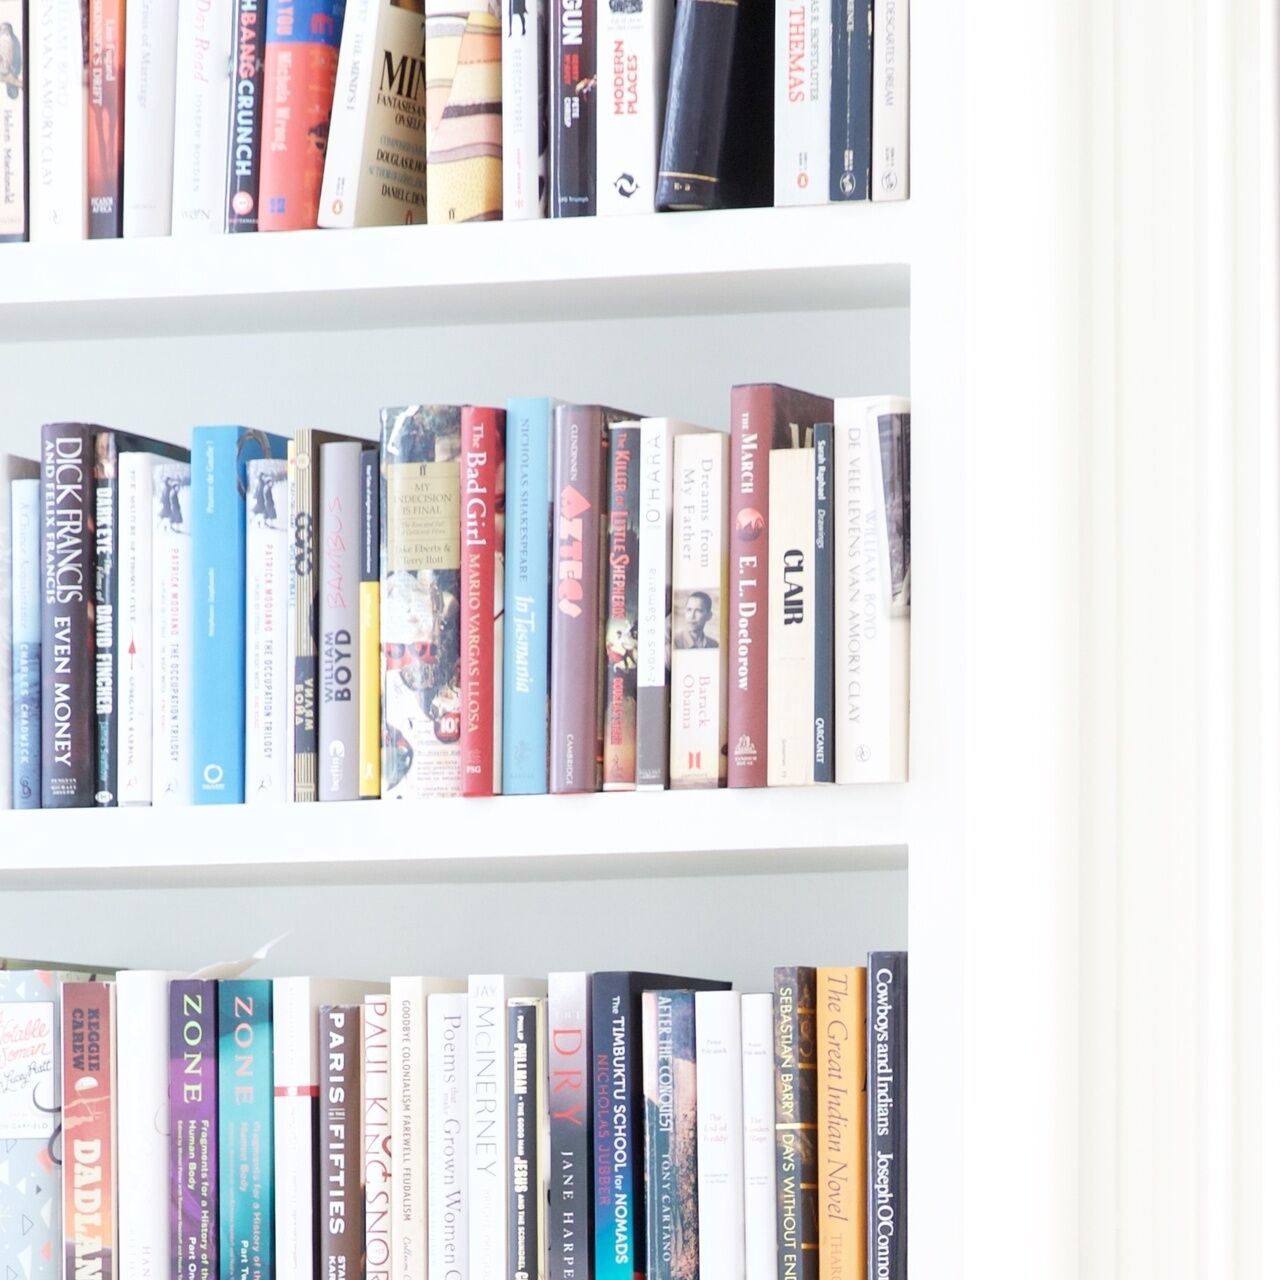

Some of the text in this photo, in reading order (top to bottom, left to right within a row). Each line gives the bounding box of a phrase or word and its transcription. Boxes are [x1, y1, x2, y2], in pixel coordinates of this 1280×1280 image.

[614, 40, 624, 115] MODERN
[627, 55, 637, 115] PLACES
[789, 6, 805, 103] THEMAS
[467, 423, 486, 547] The Bad Girl
[519, 418, 530, 583] NICHOLAS SHAKESPEARE
[740, 413, 757, 493] THE MARCH
[45, 441, 56, 604] AND FELIX FRANCIS
[55, 438, 83, 604] DICK FRANCIS
[95, 487, 111, 555] DARK EYE
[559, 485, 591, 618] AZTECS
[680, 468, 696, 560] My Father
[699, 458, 714, 567] Dreams from
[737, 556, 756, 690] E. L. Doctorow
[783, 549, 804, 625] CLAIR
[54, 616, 71, 767] EVEN MONEY
[96, 605, 112, 714] DAVID FINCHER
[468, 554, 481, 732] MARIO VARGAS LLOSA
[514, 595, 536, 692] In Tasmania
[682, 674, 696, 729] Obama
[698, 675, 711, 728] Barack
[72, 1008, 84, 1071] CAREW
[87, 1008, 100, 1071] KEGGIE
[183, 994, 202, 1104] ZONE
[235, 996, 253, 1105] ZONE
[329, 1013, 345, 1104] PARIS
[552, 1028, 583, 1128] DRY
[658, 996, 673, 1133] AFTER THE CONQUEST
[779, 987, 794, 1118] SEBASTIAN BARRY
[873, 968, 893, 1135] Cowboys and Indians
[612, 997, 628, 1264] The TIMBUKTU SCHOOL for NOMADS
[827, 974, 848, 1221] The Great Indian Novel
[329, 1124, 346, 1234] FIFTIES
[561, 1151, 574, 1200] JANE
[782, 1134, 795, 1170] DAYS
[874, 1150, 894, 1204] Joseph
[661, 1154, 671, 1262] TONY CARTANO
[782, 1177, 796, 1249] WITHOUT
